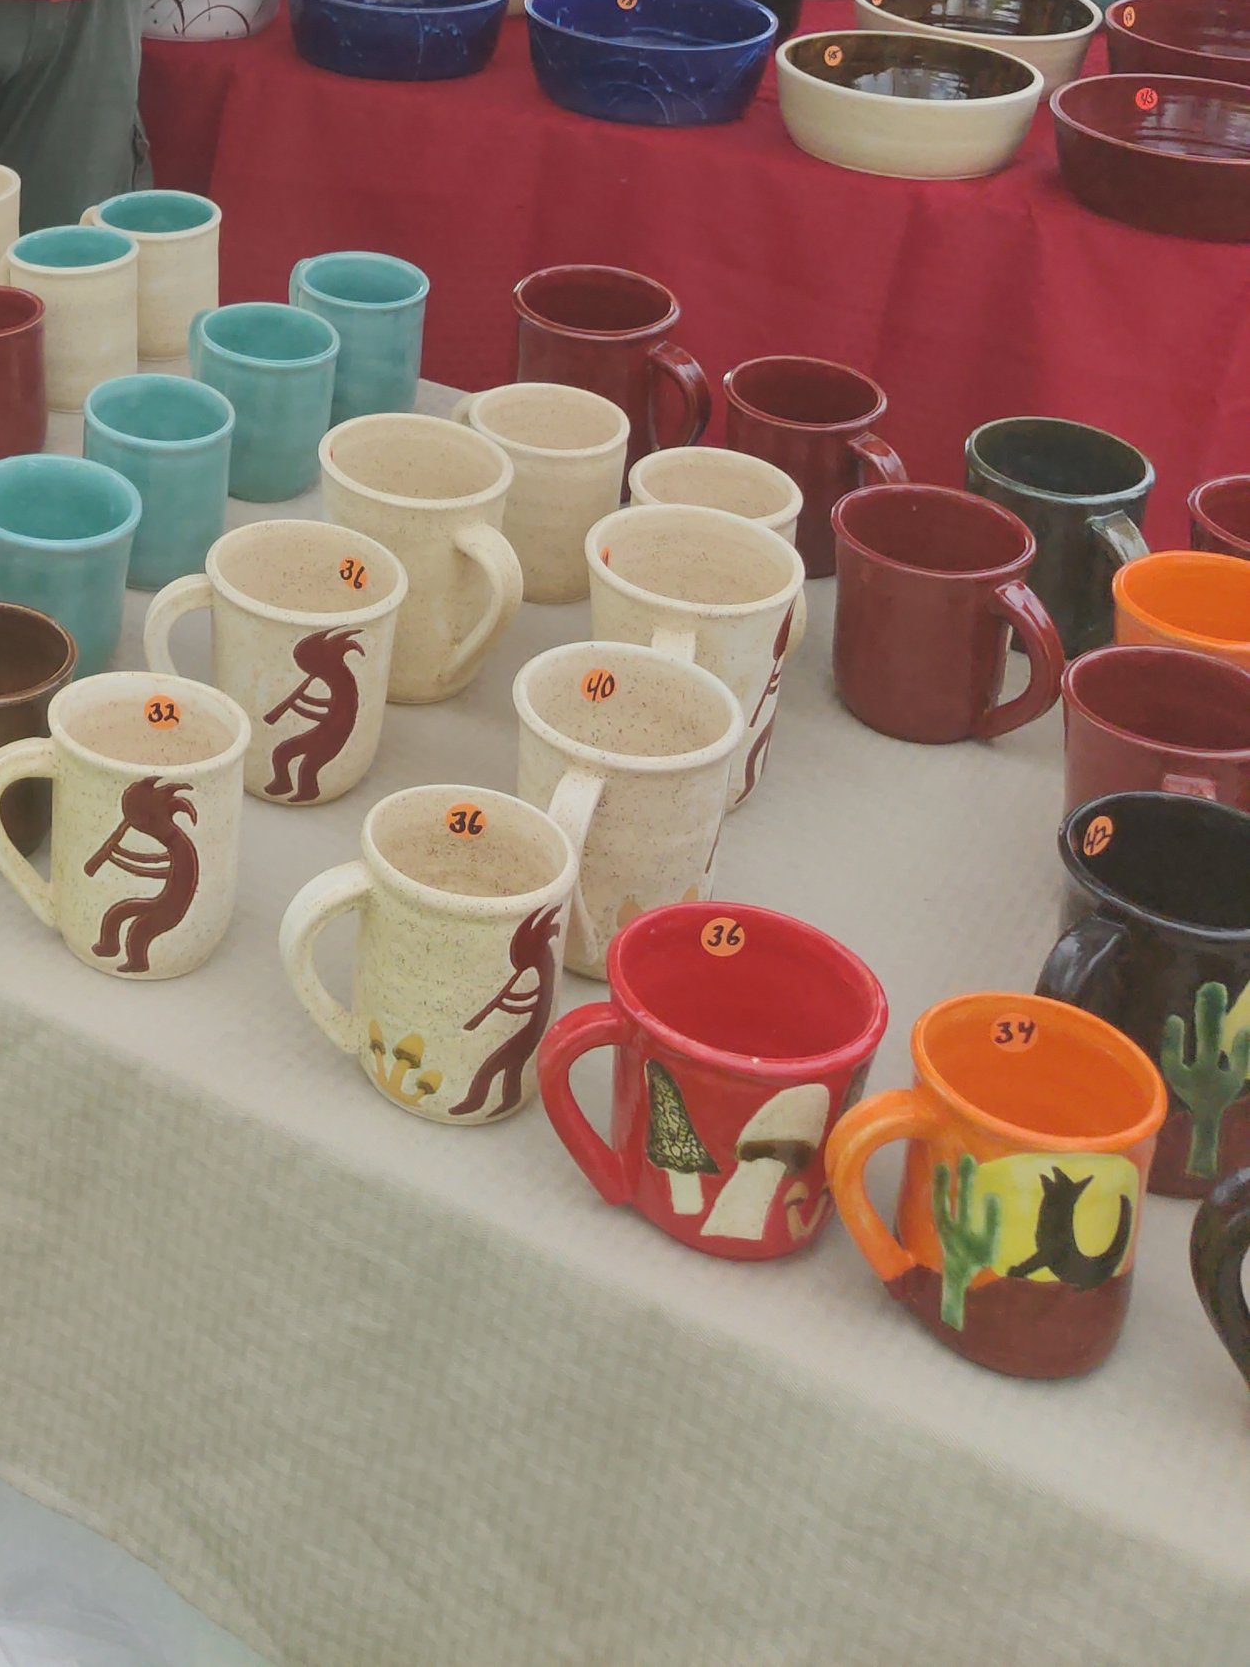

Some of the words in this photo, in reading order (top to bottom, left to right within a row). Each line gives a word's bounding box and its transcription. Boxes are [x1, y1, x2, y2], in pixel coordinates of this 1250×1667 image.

[339, 559, 366, 590] 36
[587, 672, 616, 703] 40
[147, 701, 181, 725] 32
[448, 810, 483, 836] 36
[707, 921, 742, 948] 36
[994, 1019, 1037, 1045] 34
